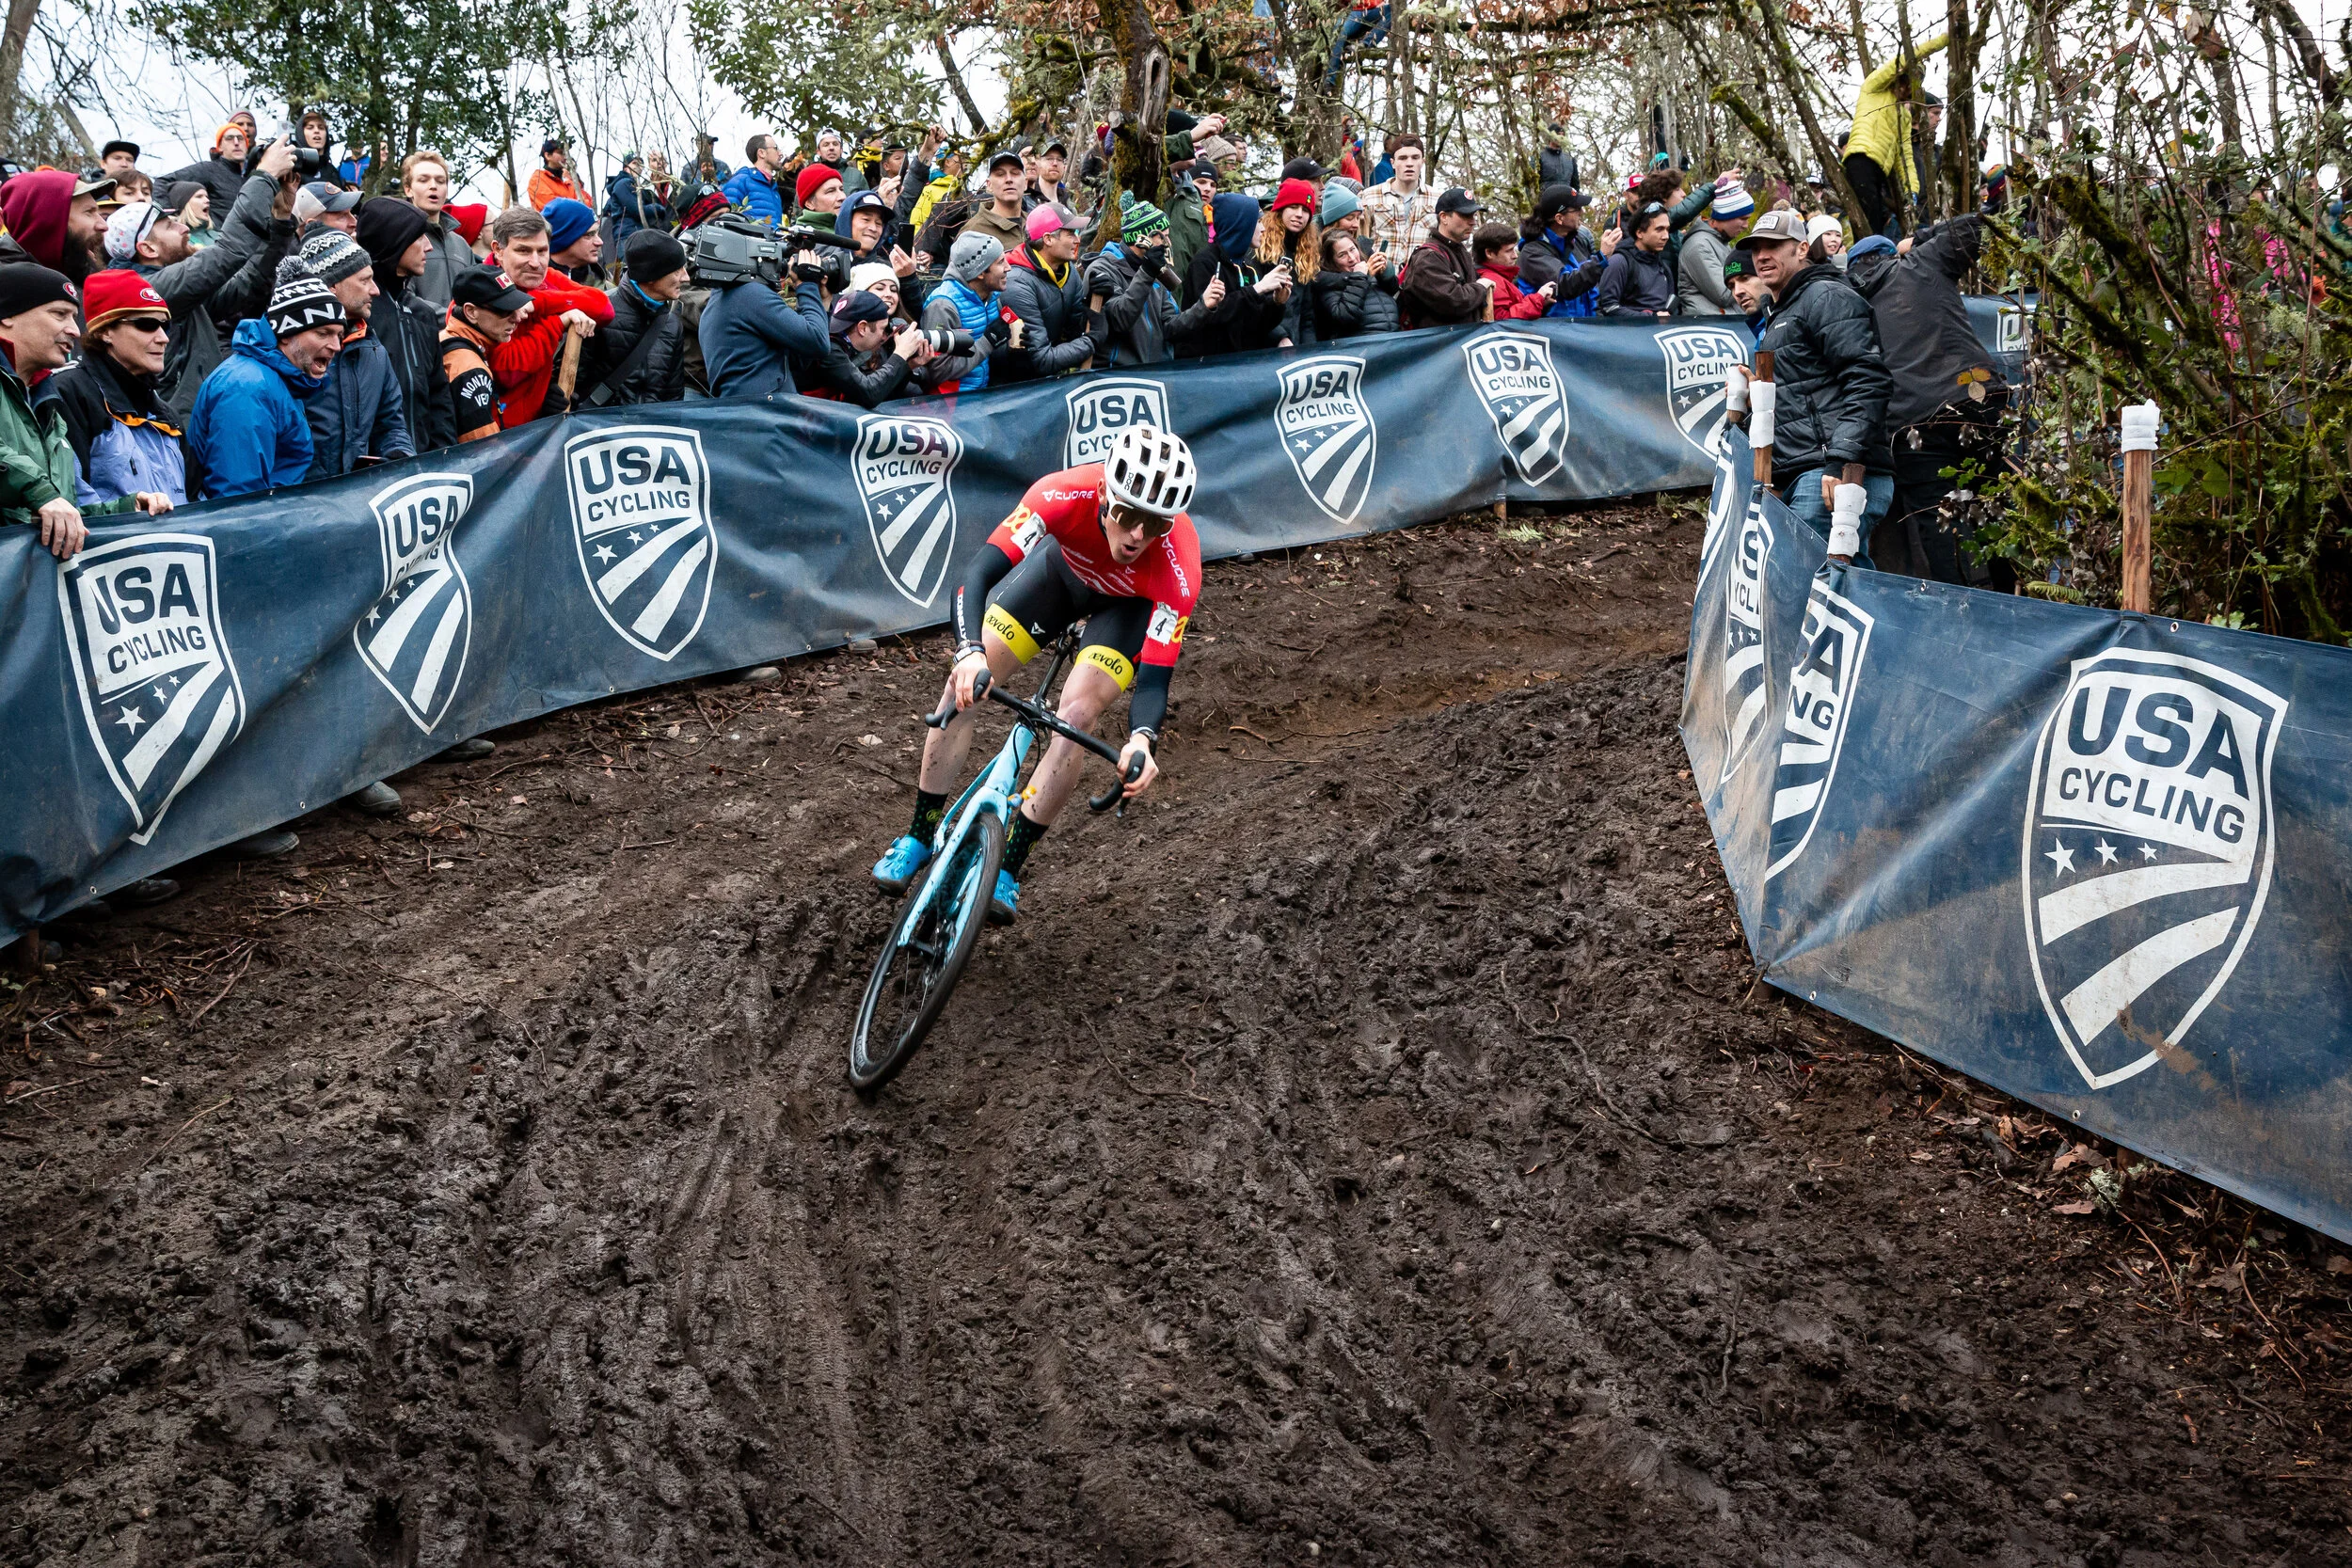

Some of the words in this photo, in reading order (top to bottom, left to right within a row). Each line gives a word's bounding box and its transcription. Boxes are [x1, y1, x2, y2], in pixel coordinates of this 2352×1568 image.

[1476, 345, 1548, 375] USA
[1670, 338, 1738, 362] USA
[1488, 375, 1550, 390] CYCLING
[1677, 362, 1737, 380] CYCLIN
[1289, 371, 1350, 404] USA
[1076, 395, 1156, 434] USA
[1286, 403, 1356, 423] CYCLING
[866, 424, 948, 460] USA
[580, 446, 691, 495] USA
[866, 459, 942, 484] CYCLING
[588, 490, 691, 522] CYCLING
[1055, 490, 1095, 500] CUORE
[393, 495, 458, 559] USA
[1024, 531, 1038, 547] 4
[1167, 548, 1190, 598] CUORE
[90, 563, 200, 635] USA
[1155, 617, 1168, 637] 4
[107, 626, 206, 674] CYCLING
[2068, 686, 2249, 800] USA
[2059, 767, 2245, 845] CYCLING
